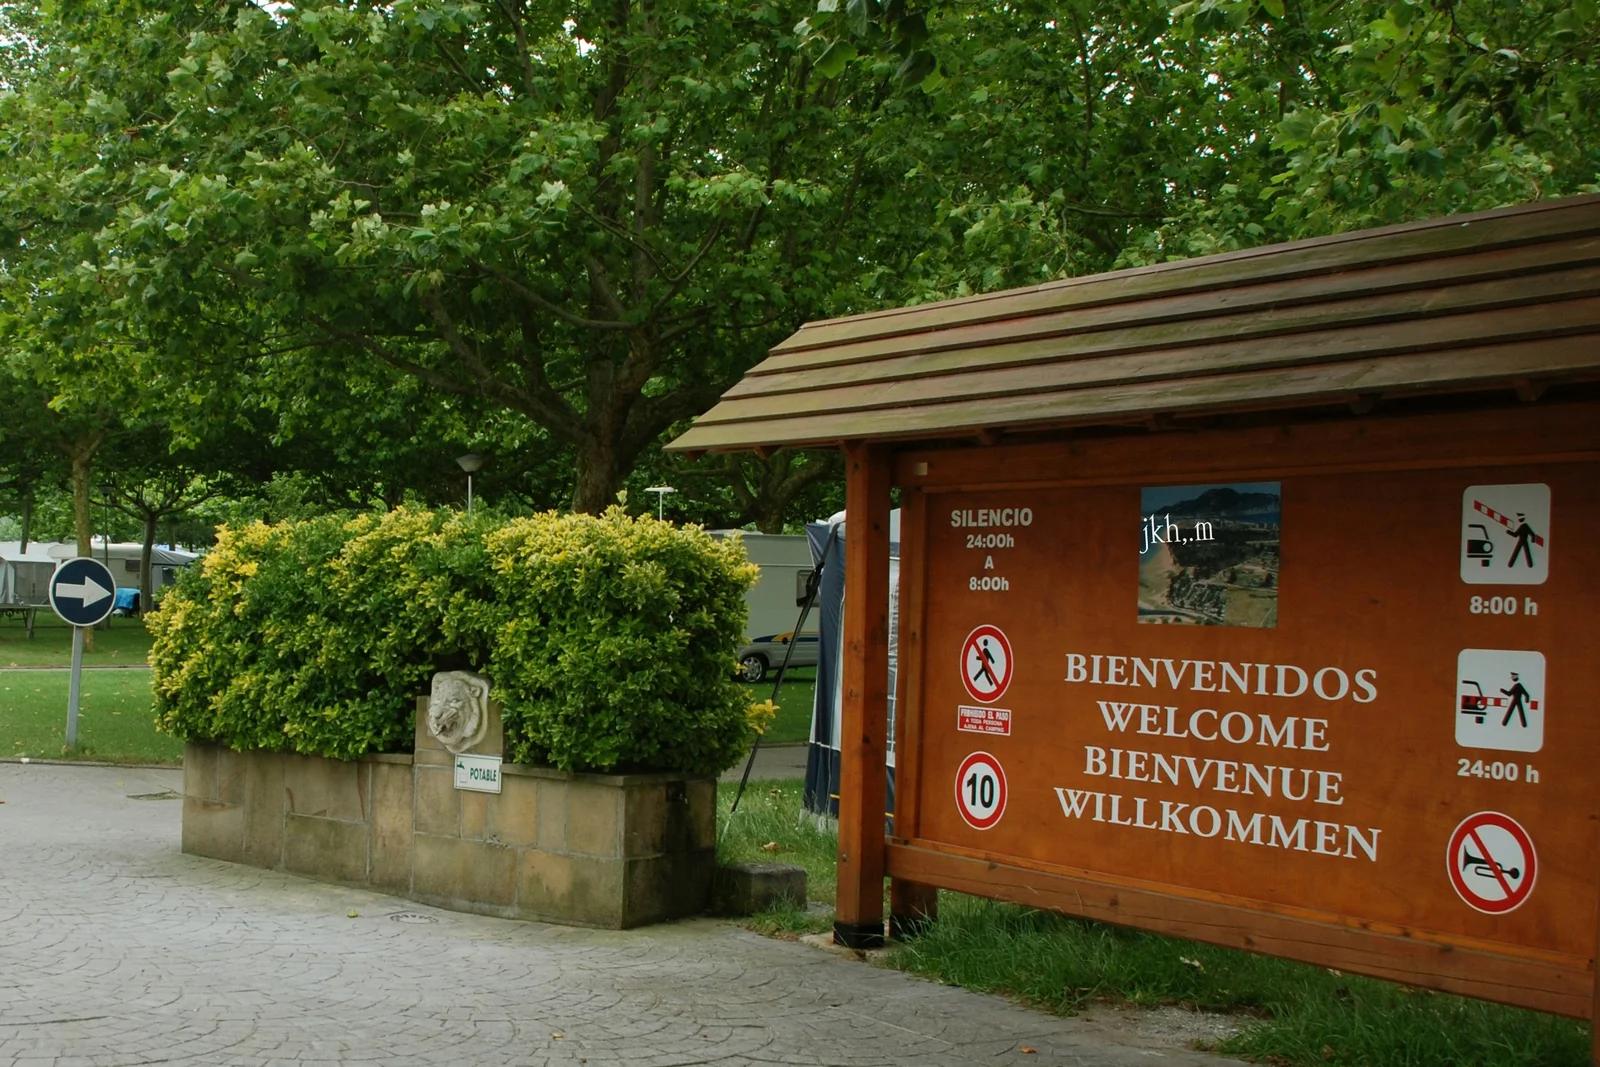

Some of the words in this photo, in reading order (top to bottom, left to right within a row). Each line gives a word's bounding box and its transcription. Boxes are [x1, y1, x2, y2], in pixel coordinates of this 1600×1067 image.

[951, 508, 1033, 527] SILENCIO
[966, 533, 1015, 548] 24:00h
[984, 555, 994, 569] A
[969, 576, 1009, 591] 8:00h
[1469, 596, 1518, 615] 8:00
[1524, 597, 1538, 615] h
[1064, 653, 1378, 703] BIENVENIDOS
[1096, 700, 1330, 752] WELCOME
[470, 768, 497, 782] POTABLE
[1083, 745, 1344, 805] BIENVENUE
[1457, 758, 1519, 782] 24:00
[1525, 764, 1540, 784] h
[966, 772, 994, 809] 10
[1053, 786, 1382, 862] WILLKOMMEN
